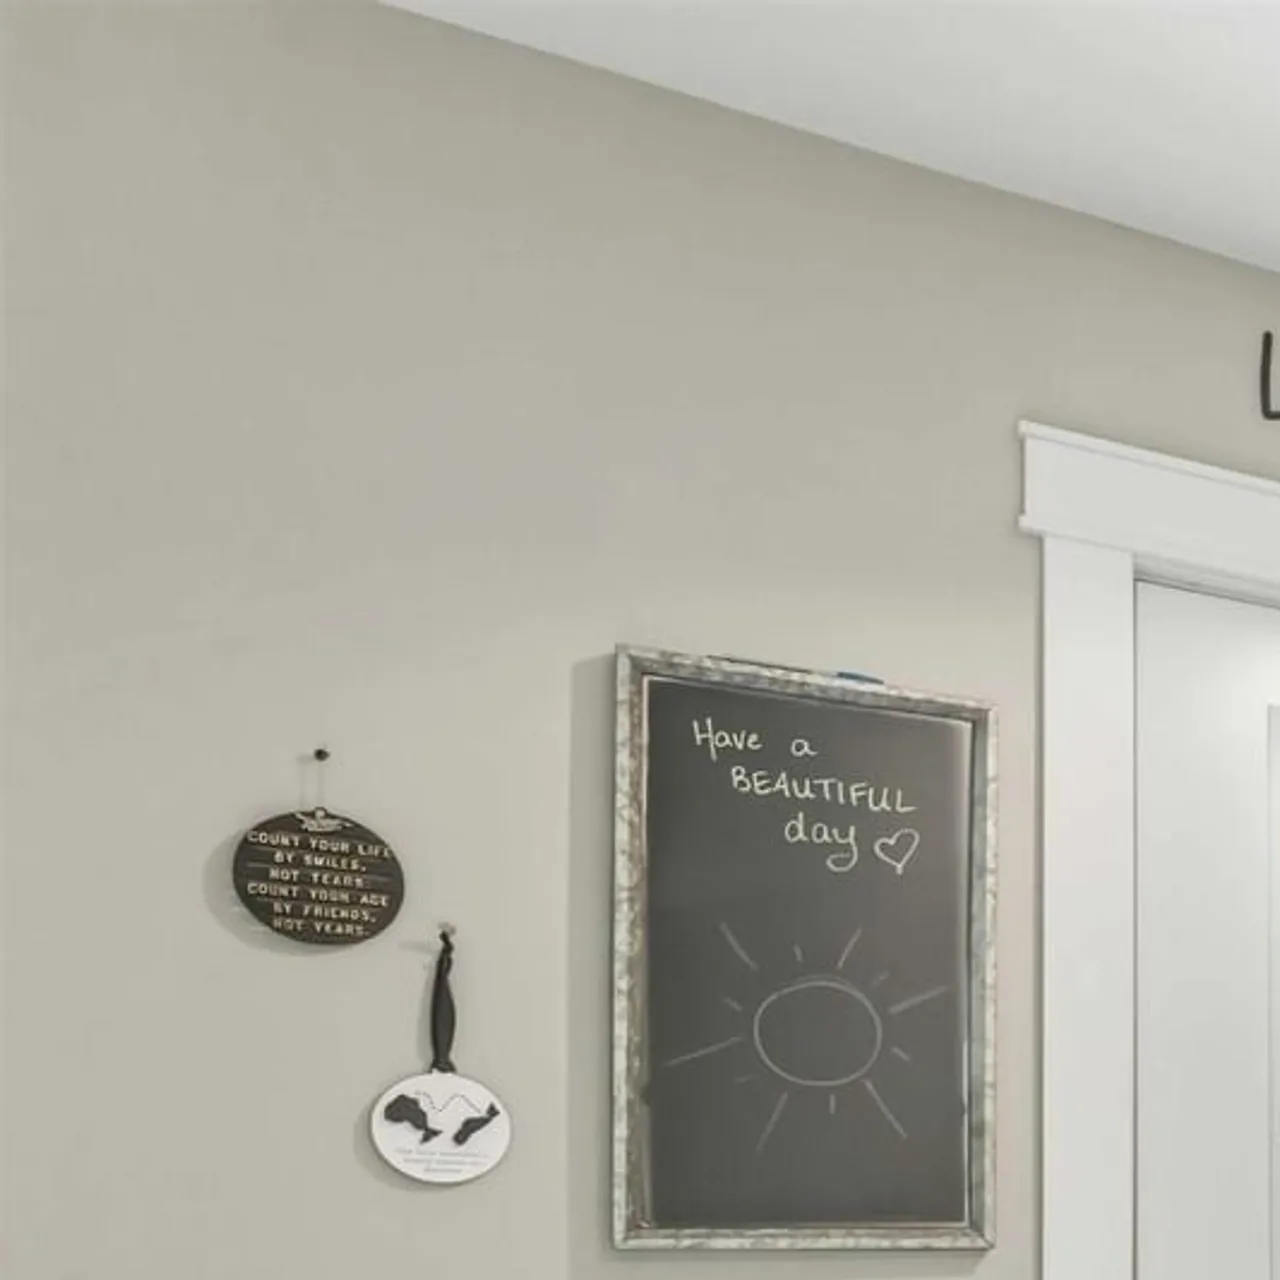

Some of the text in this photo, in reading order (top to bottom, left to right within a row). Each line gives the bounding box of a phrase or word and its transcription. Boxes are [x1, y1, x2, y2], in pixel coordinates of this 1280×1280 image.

[692, 716, 819, 761] Have a
[731, 766, 917, 813] BEAUTIFUL
[247, 831, 391, 859] COUNT YOUR LIFE
[784, 812, 858, 872] day
[273, 851, 294, 863] BY
[269, 868, 300, 881] NOT
[247, 883, 390, 907] COUNT YOUR AGE
[273, 902, 294, 915] BY
[273, 919, 302, 931] NOT
